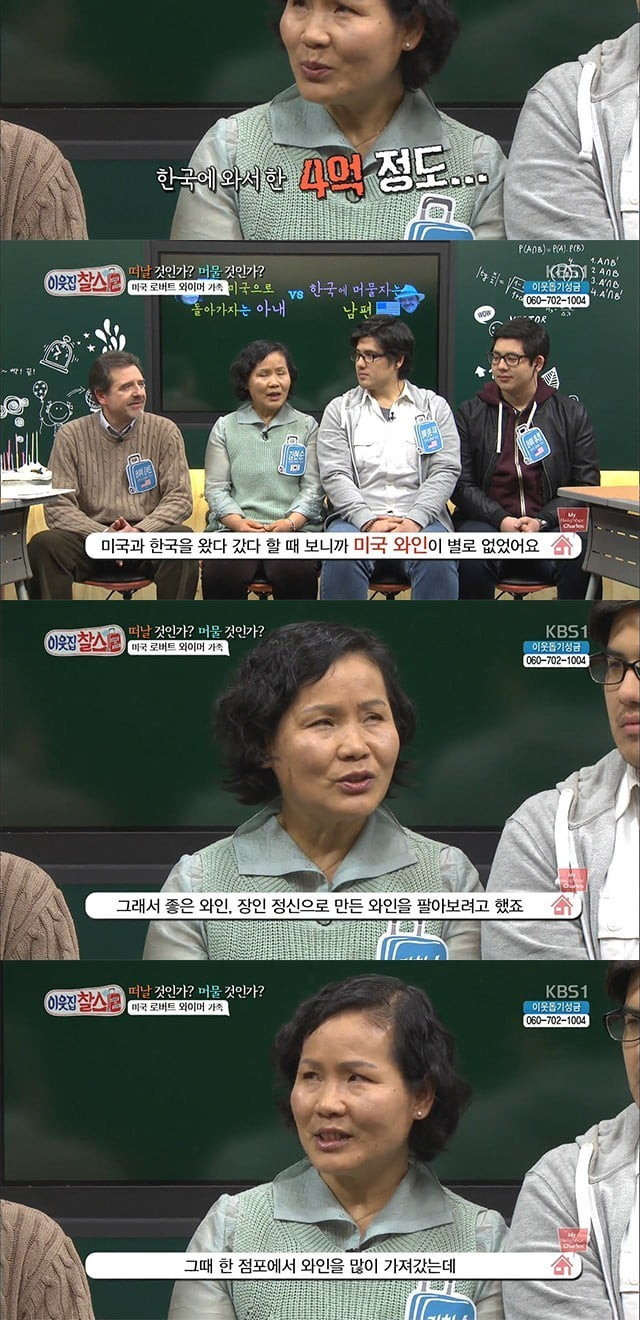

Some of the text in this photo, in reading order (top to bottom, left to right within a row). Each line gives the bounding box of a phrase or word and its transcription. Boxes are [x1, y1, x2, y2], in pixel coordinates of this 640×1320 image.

[228, 281, 275, 295] 미국으로
[309, 280, 349, 298] 한국에
[191, 299, 287, 318] 돌아가자는 아내
[343, 301, 372, 320] 남편
